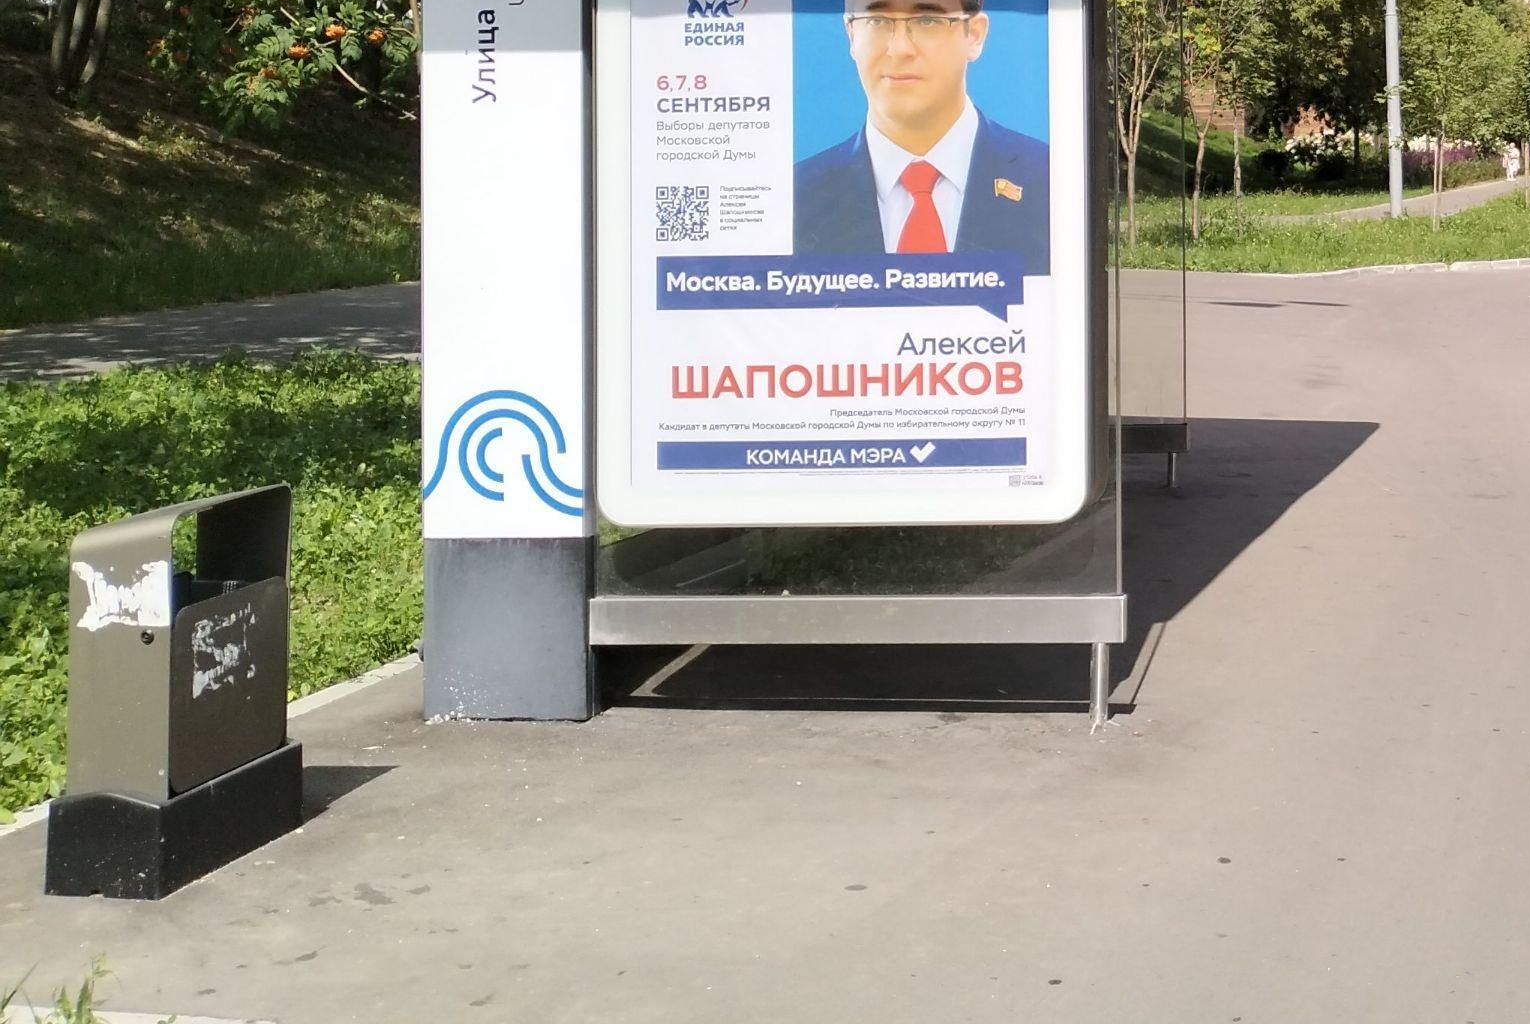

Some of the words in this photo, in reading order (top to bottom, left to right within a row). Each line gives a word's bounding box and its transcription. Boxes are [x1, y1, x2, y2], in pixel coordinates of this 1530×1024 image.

[684, 22, 745, 33] ЕДИНАЯ
[684, 35, 745, 46] РОССИЯ
[471, 8, 499, 103] Улица
[656, 96, 770, 113] СЕНТЯБРЯ
[656, 120, 704, 132] Выборы
[708, 120, 770, 132] депутатов
[656, 135, 730, 146] Московской
[656, 150, 719, 162] городской
[723, 149, 756, 161] Думы
[666, 271, 761, 292] Москва.
[767, 270, 879, 295] Будущее.
[885, 268, 1005, 290] Развитие.
[897, 329, 1026, 356] Алексей
[671, 361, 1023, 399] ШАПОШНИКОВ
[830, 408, 892, 418] Председатель
[894, 407, 949, 416] Московской
[951, 407, 999, 416] городской
[1001, 406, 1026, 415] Думы
[658, 422, 700, 431] Кандидат
[709, 423, 750, 432] депутаты
[752, 421, 806, 430] Московской
[808, 421, 855, 431] городской
[857, 421, 881, 429] Думы
[896, 419, 969, 429] избирательному
[973, 419, 1002, 428] округу
[1005, 418, 1015, 426] №
[1018, 418, 1026, 426] 11
[746, 448, 847, 466] КОМАНДА
[850, 448, 906, 464] МЭРА
